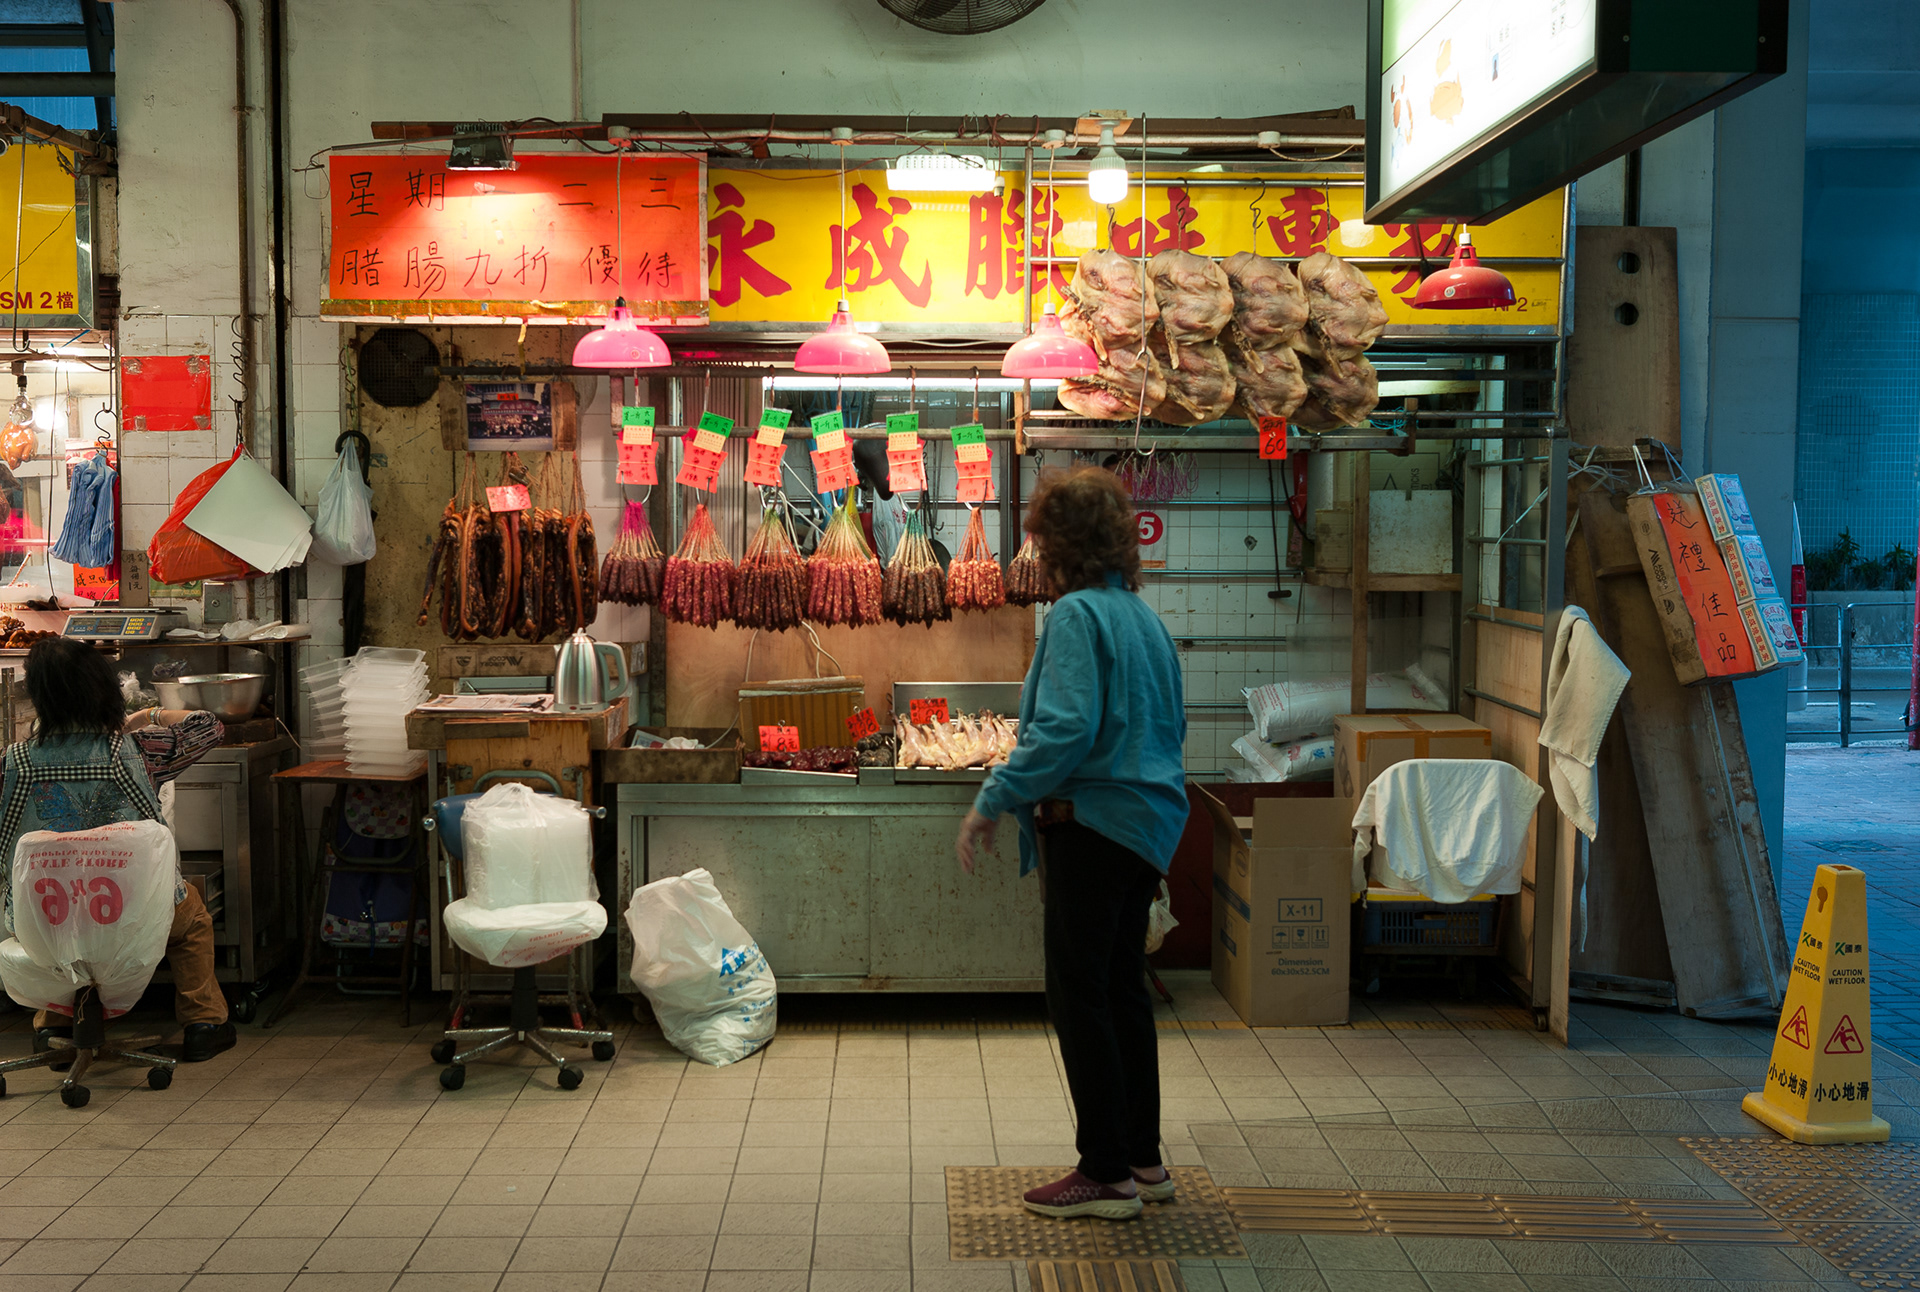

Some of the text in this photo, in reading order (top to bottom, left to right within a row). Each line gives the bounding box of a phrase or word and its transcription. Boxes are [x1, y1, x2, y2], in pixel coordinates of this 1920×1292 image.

[0, 291, 74, 310] SM 2 檔
[1265, 437, 1285, 455] 60
[1138, 516, 1154, 539] 5
[1667, 500, 1737, 662] 送禮佳品
[1286, 904, 1315, 917] X-11
[1278, 957, 1324, 967] Dimension
[1796, 957, 1820, 974] CAUTION
[1793, 965, 1821, 983] WET FLOOR
[1828, 976, 1866, 985] WET FLOOR
[1832, 968, 1863, 977] CAUTION
[1768, 1062, 1808, 1100] 小心地滑
[1814, 1081, 1870, 1102] 小心地滑
